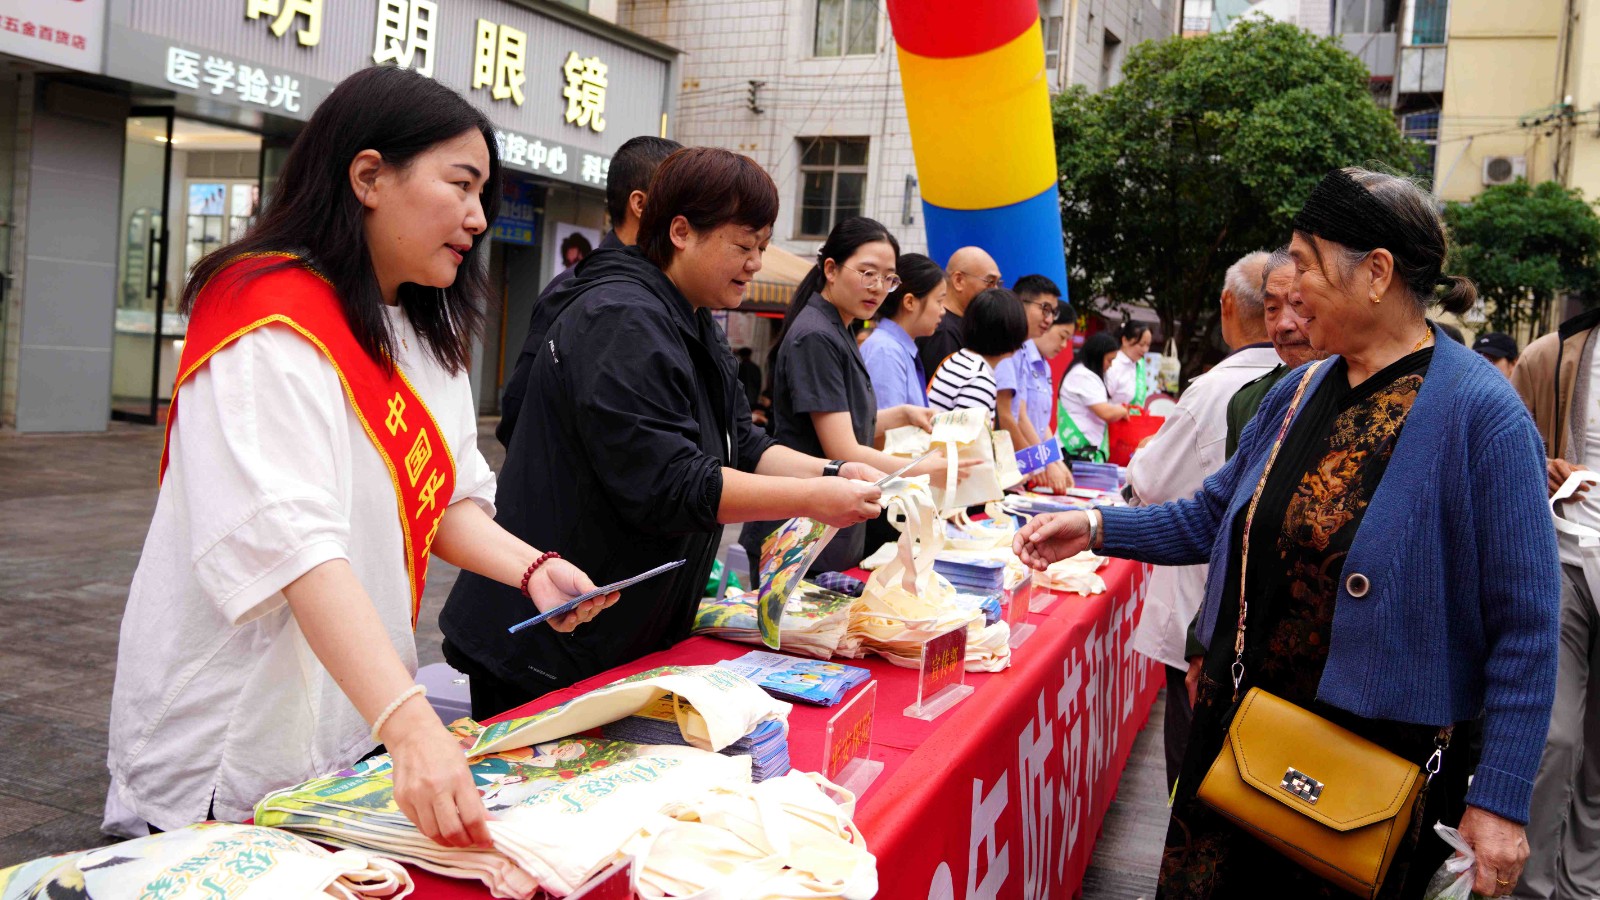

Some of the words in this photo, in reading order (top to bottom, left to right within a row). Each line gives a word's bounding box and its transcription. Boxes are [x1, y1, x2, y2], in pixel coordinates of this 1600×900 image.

[0, 15, 87, 50] 五金百货店
[166, 46, 302, 113] 医学验光
[927, 563, 1155, 900] 年防范和打击
